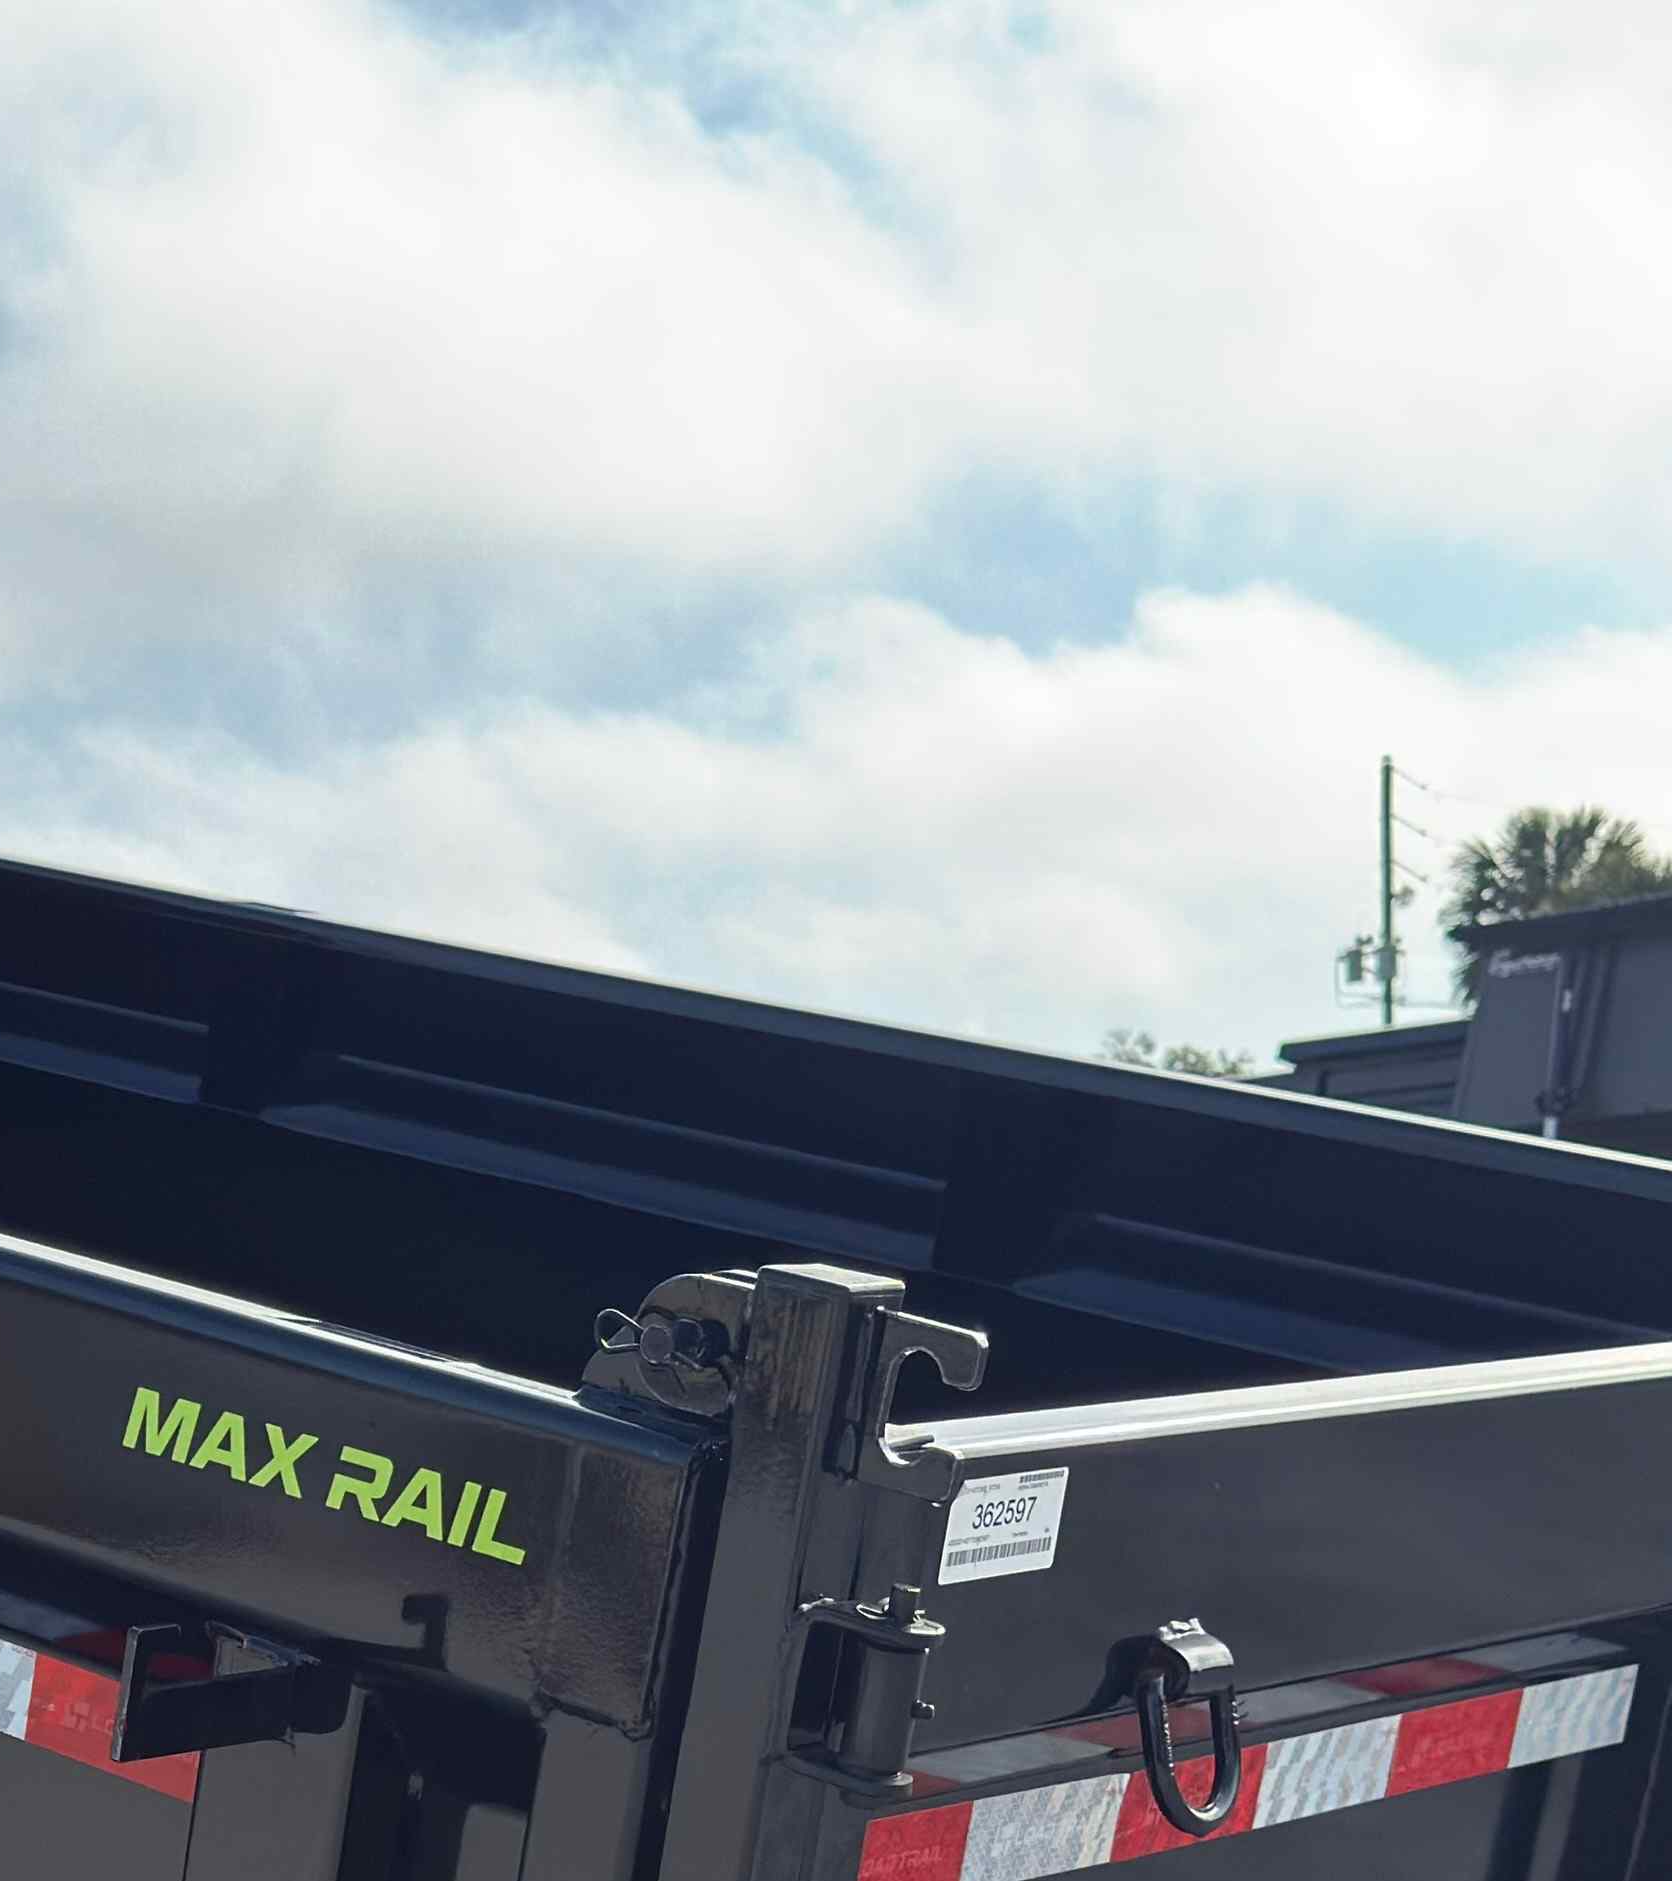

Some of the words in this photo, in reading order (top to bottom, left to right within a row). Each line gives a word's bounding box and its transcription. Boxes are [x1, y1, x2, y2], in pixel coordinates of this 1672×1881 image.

[122, 1386, 319, 1498] MAX
[325, 1445, 527, 1566] RAIL
[972, 1496, 1037, 1530] 362597
